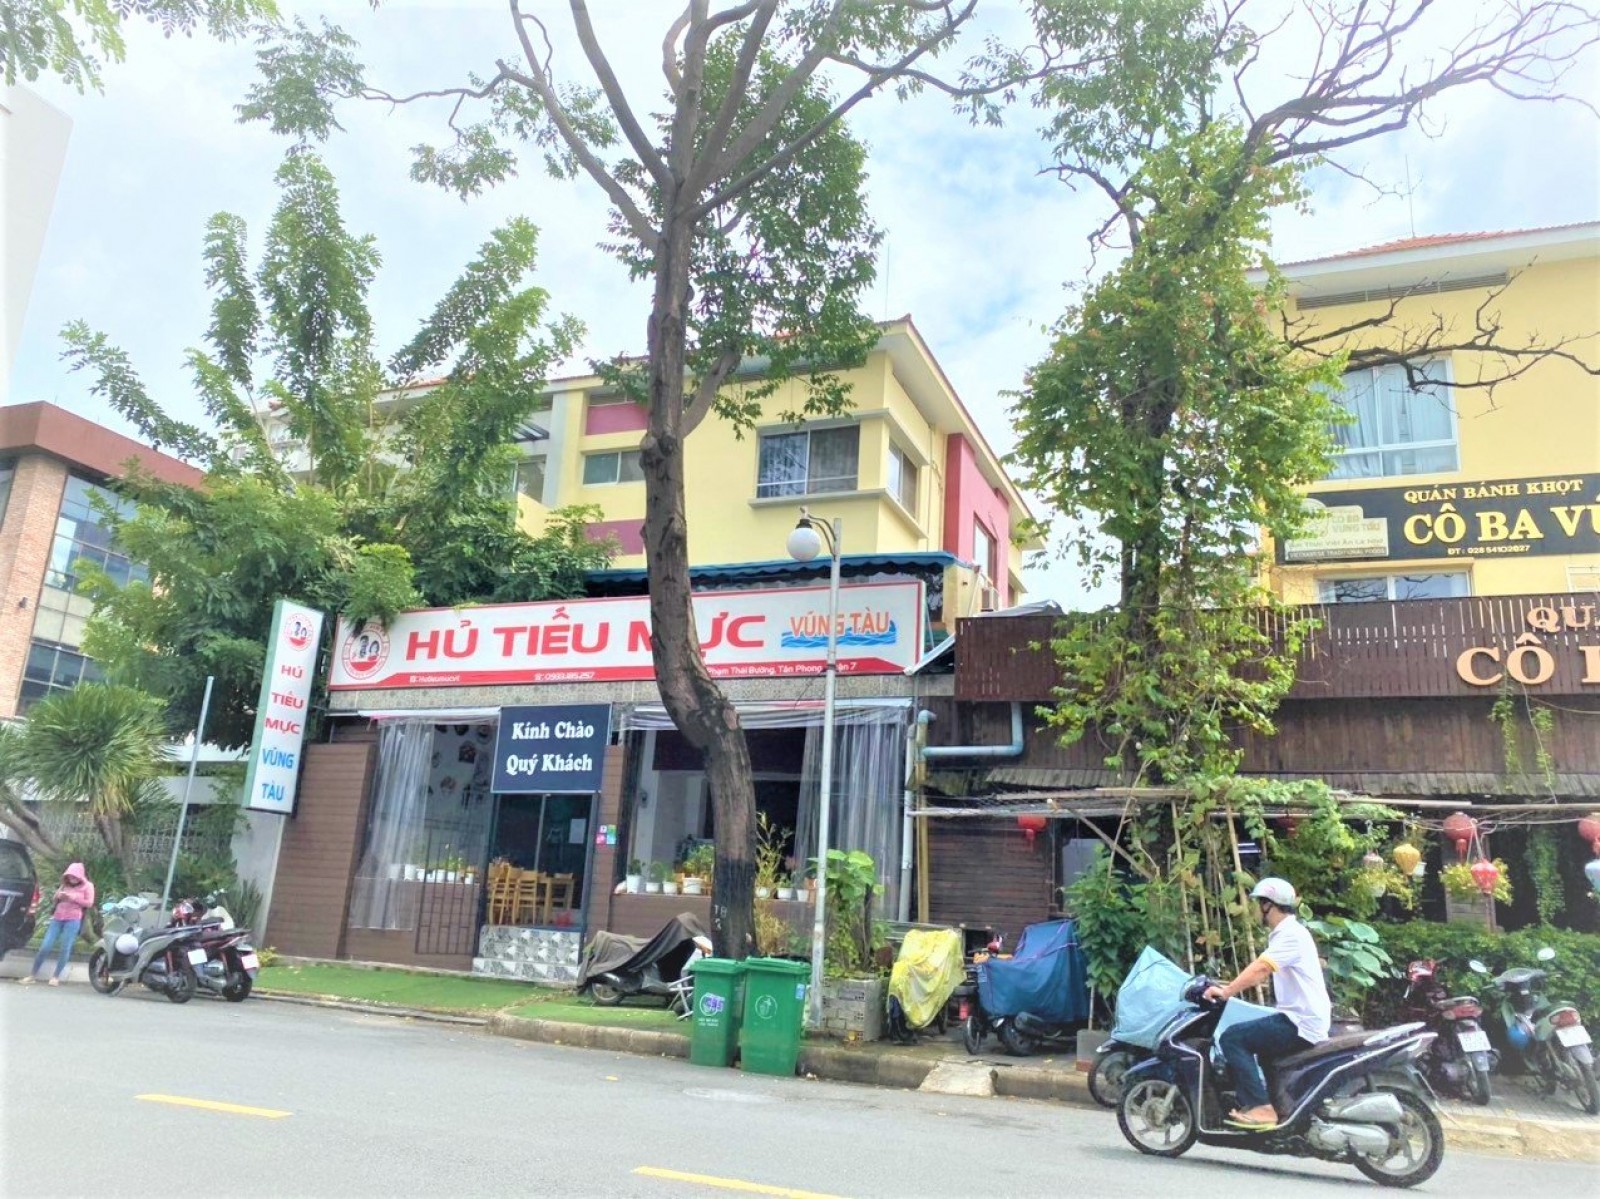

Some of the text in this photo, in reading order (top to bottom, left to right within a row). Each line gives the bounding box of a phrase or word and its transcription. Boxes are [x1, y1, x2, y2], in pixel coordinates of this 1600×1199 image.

[1403, 479, 1583, 504] QUÁN BÁNH KHỌT
[1403, 502, 1467, 545] CÔ
[1475, 508, 1545, 542] BA
[850, 607, 890, 634] TÀU
[1526, 605, 1600, 633] QU
[405, 620, 479, 661] HỦ
[493, 606, 610, 657] TIẾU
[850, 661, 857, 670] 7
[1456, 632, 1555, 686] CÔ
[281, 664, 303, 679] HỦ
[265, 717, 301, 735] MỰC
[511, 720, 595, 740] Kính Chào
[505, 752, 593, 776] Quý Khách
[261, 779, 285, 801] TÀU
